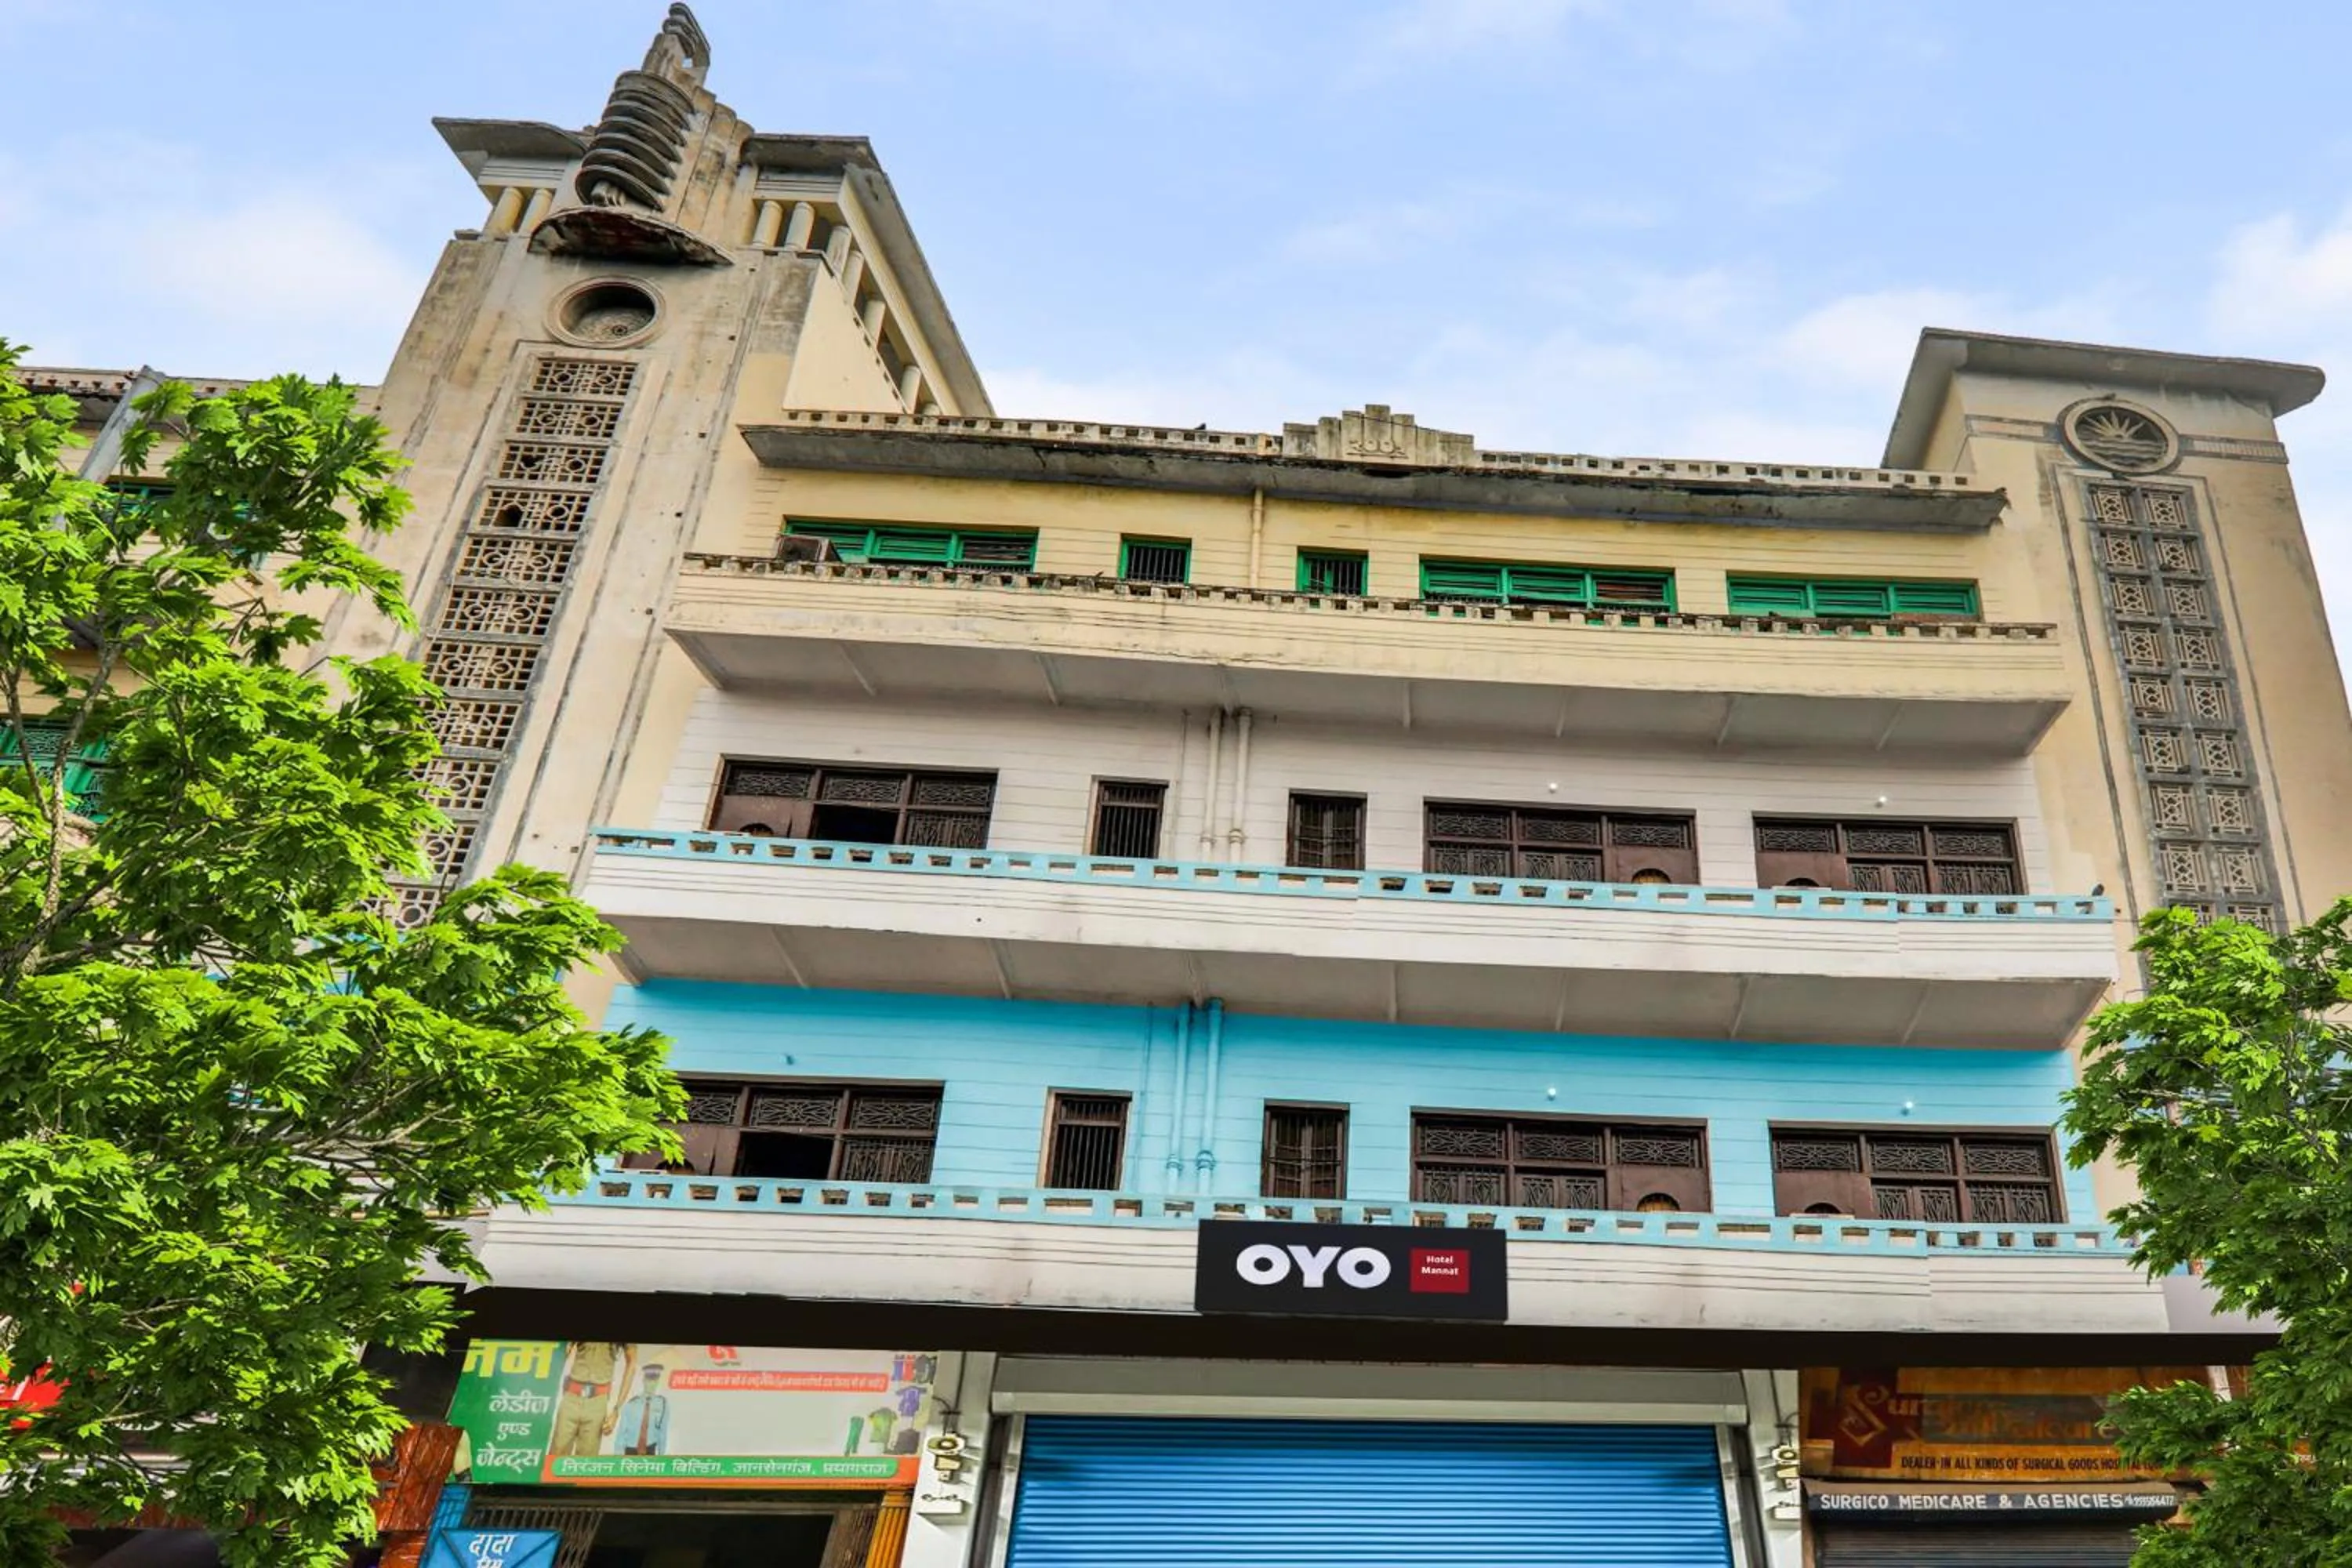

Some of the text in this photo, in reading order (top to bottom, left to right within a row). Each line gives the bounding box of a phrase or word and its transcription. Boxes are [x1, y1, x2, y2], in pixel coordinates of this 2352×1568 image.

[1236, 1244, 1392, 1288] OYO
[1426, 1255, 1454, 1265] Hotel
[1421, 1265, 1459, 1276] Mannat
[620, 1458, 665, 1473] सिनेमा
[1955, 1457, 1971, 1469] ALL
[1975, 1457, 2005, 1470] KINDS
[2006, 1457, 2019, 1470] OF
[2022, 1457, 2065, 1470] SURGICAL
[1820, 1494, 1889, 1509] SURGICO
[1898, 1494, 1987, 1509] MEDICARE
[1999, 1494, 2013, 1509] &
[2024, 1494, 2124, 1508] AGENCIES
